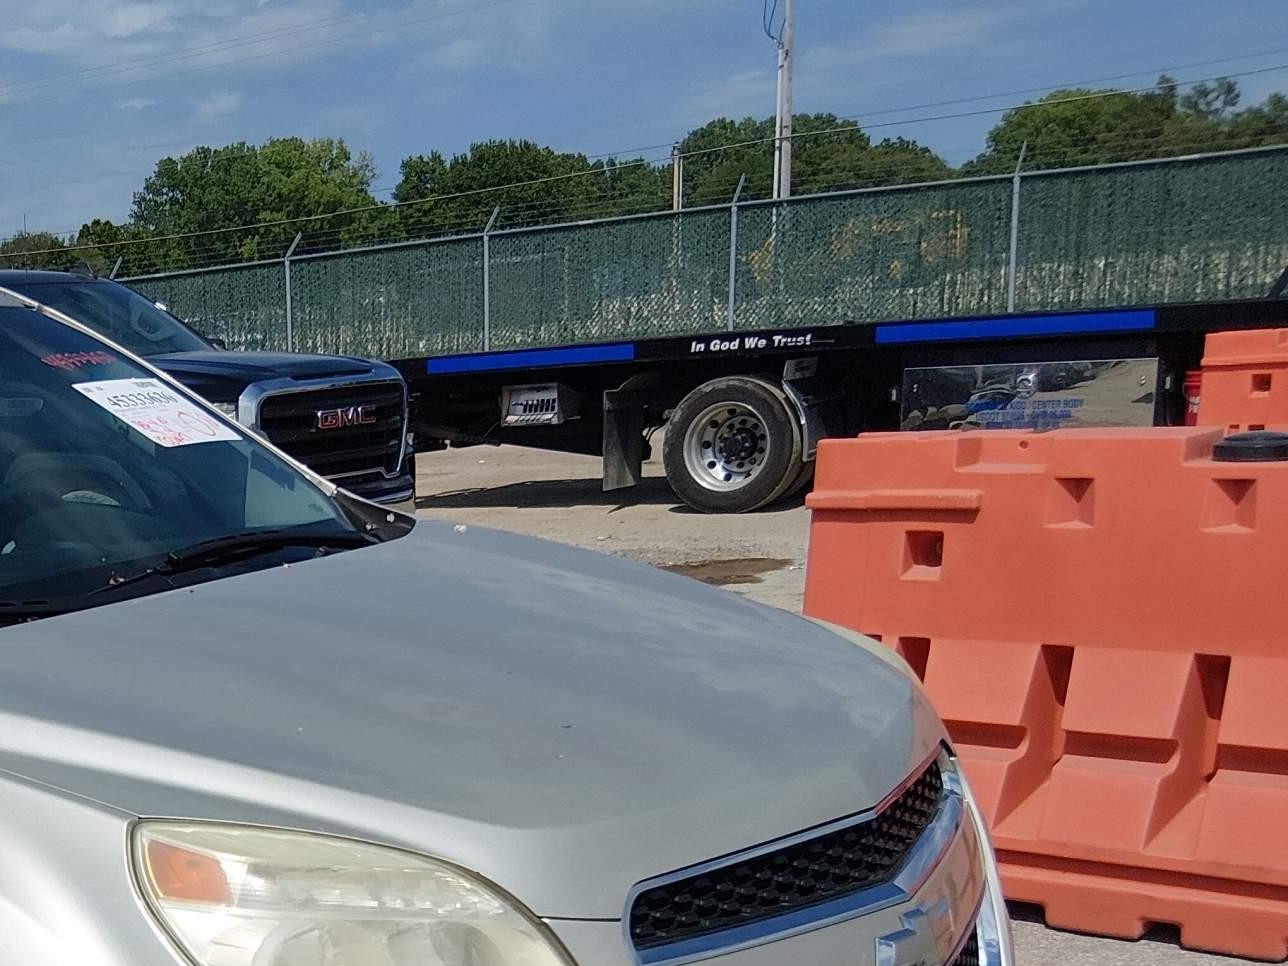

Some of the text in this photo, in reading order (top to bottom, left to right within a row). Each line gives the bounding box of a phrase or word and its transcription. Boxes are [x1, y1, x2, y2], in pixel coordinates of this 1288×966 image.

[690, 341, 705, 352] In
[709, 338, 740, 351] God
[744, 336, 767, 349] We
[106, 391, 178, 407] 45333630
[317, 404, 376, 429] GMC
